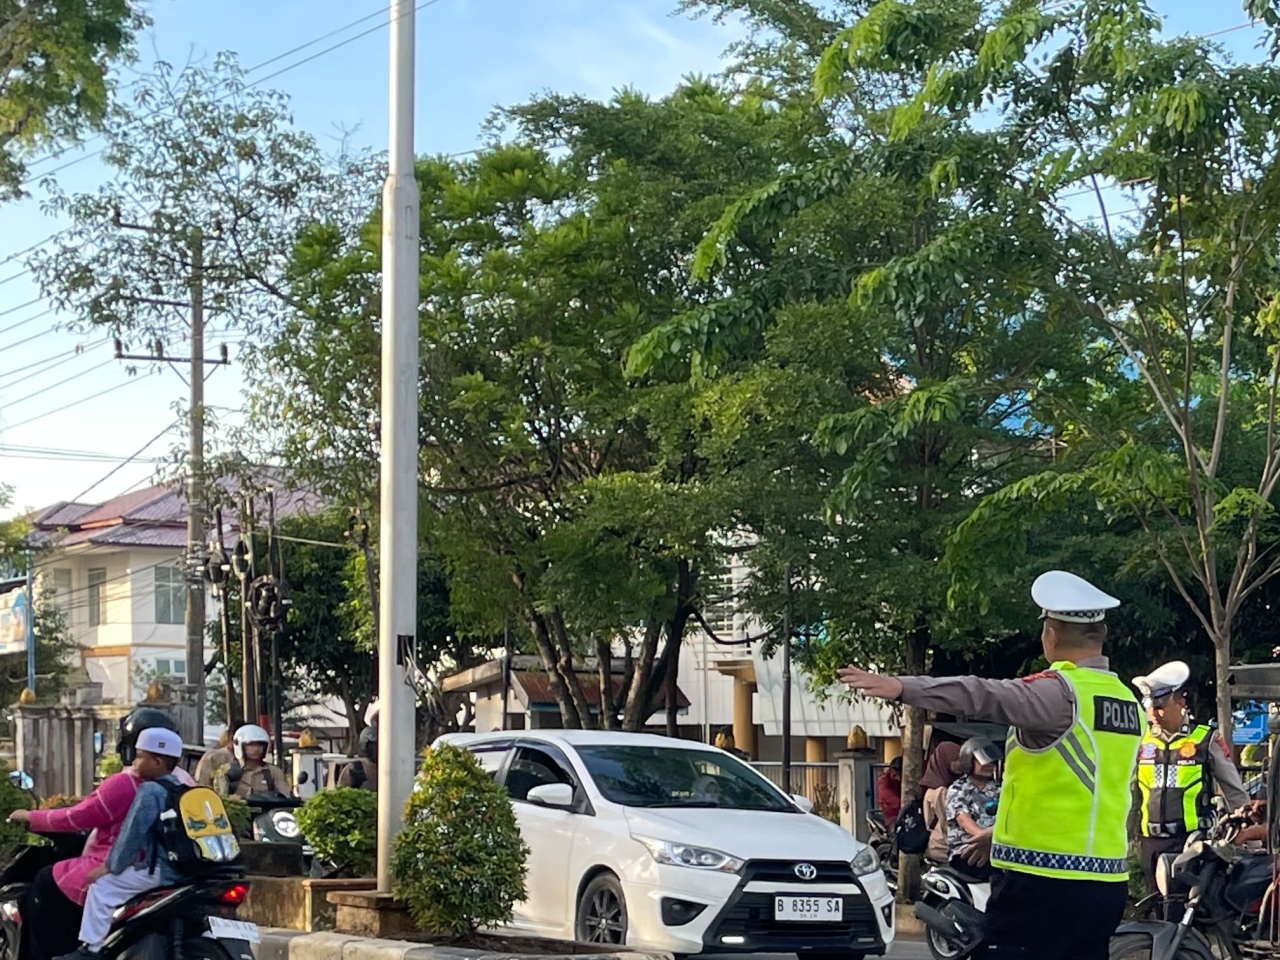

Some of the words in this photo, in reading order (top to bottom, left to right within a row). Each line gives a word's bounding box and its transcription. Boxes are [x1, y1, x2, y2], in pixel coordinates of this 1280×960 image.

[777, 899, 784, 912] B
[792, 899, 819, 912] 8355
[826, 900, 840, 913] SA
